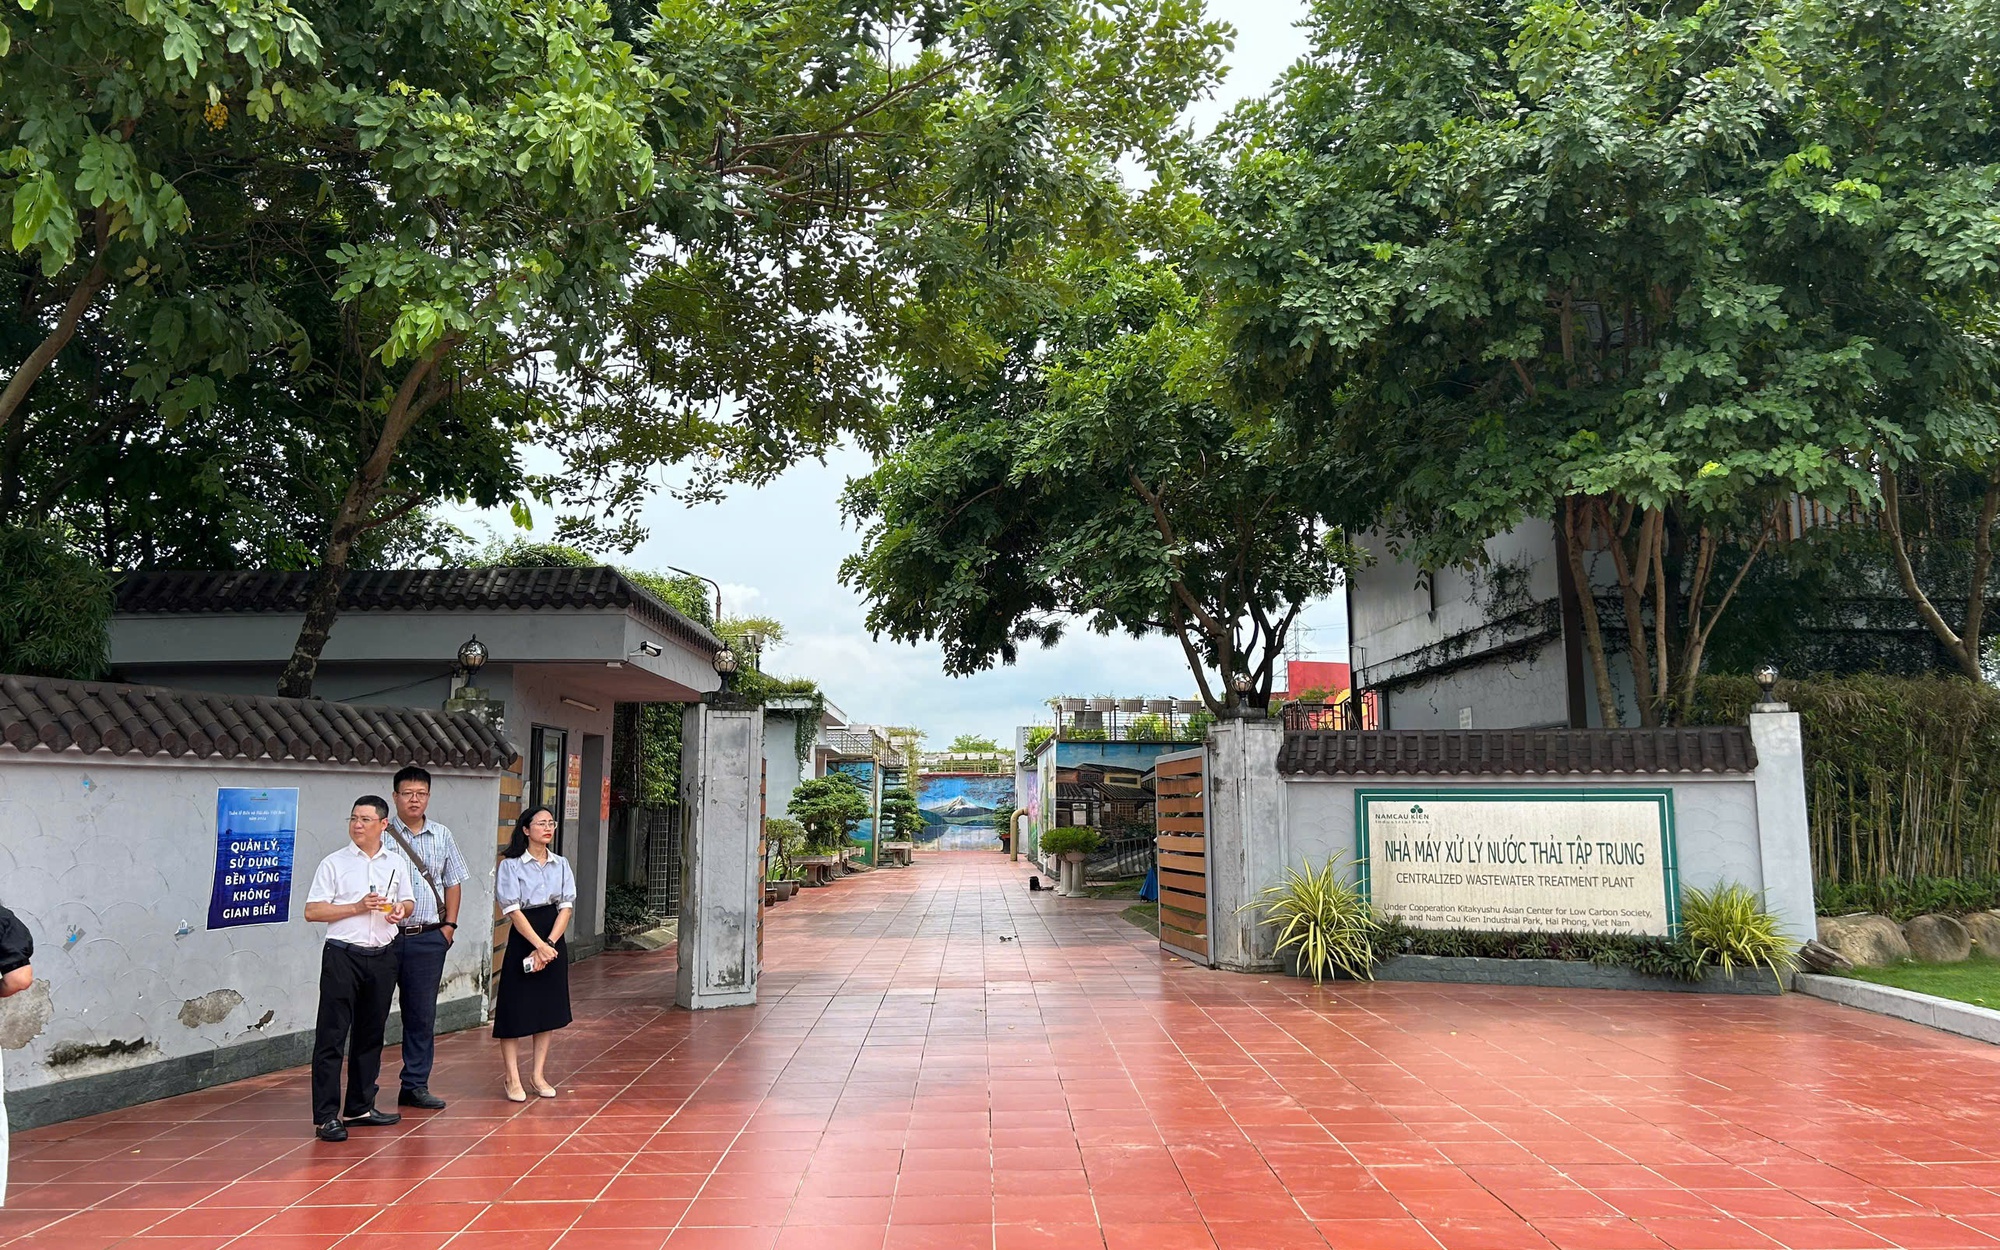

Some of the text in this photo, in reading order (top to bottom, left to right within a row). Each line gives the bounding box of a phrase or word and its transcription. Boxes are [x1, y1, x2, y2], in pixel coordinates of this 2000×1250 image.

[230, 838, 280, 854] QUẢN LÝ,
[1385, 833, 1645, 870] NHÀ MÁY XỬ LÝ NƯỚC THẢI TẬP TRUNG
[229, 855, 279, 869] SỬ DỤNG
[225, 870, 280, 885] BỀN VỮNG
[1396, 872, 1634, 887] CENTRALIZED WASTEWATER TREATMENT PLANT
[233, 887, 271, 902] KHÔNG
[222, 901, 276, 919] GIAN BIỂN
[1384, 903, 1652, 918] Under Cooperation Kitakyushu Asian Center for Low Carbon Society,
[1409, 913, 1423, 921] and
[1425, 914, 1444, 922] Nam
[1445, 915, 1461, 923] Cau
[1463, 915, 1481, 923] Kien
[1483, 915, 1520, 924] Industrial
[1523, 916, 1543, 925] Park,
[1561, 918, 1590, 927] Phong,
[1610, 919, 1630, 927] Nam
